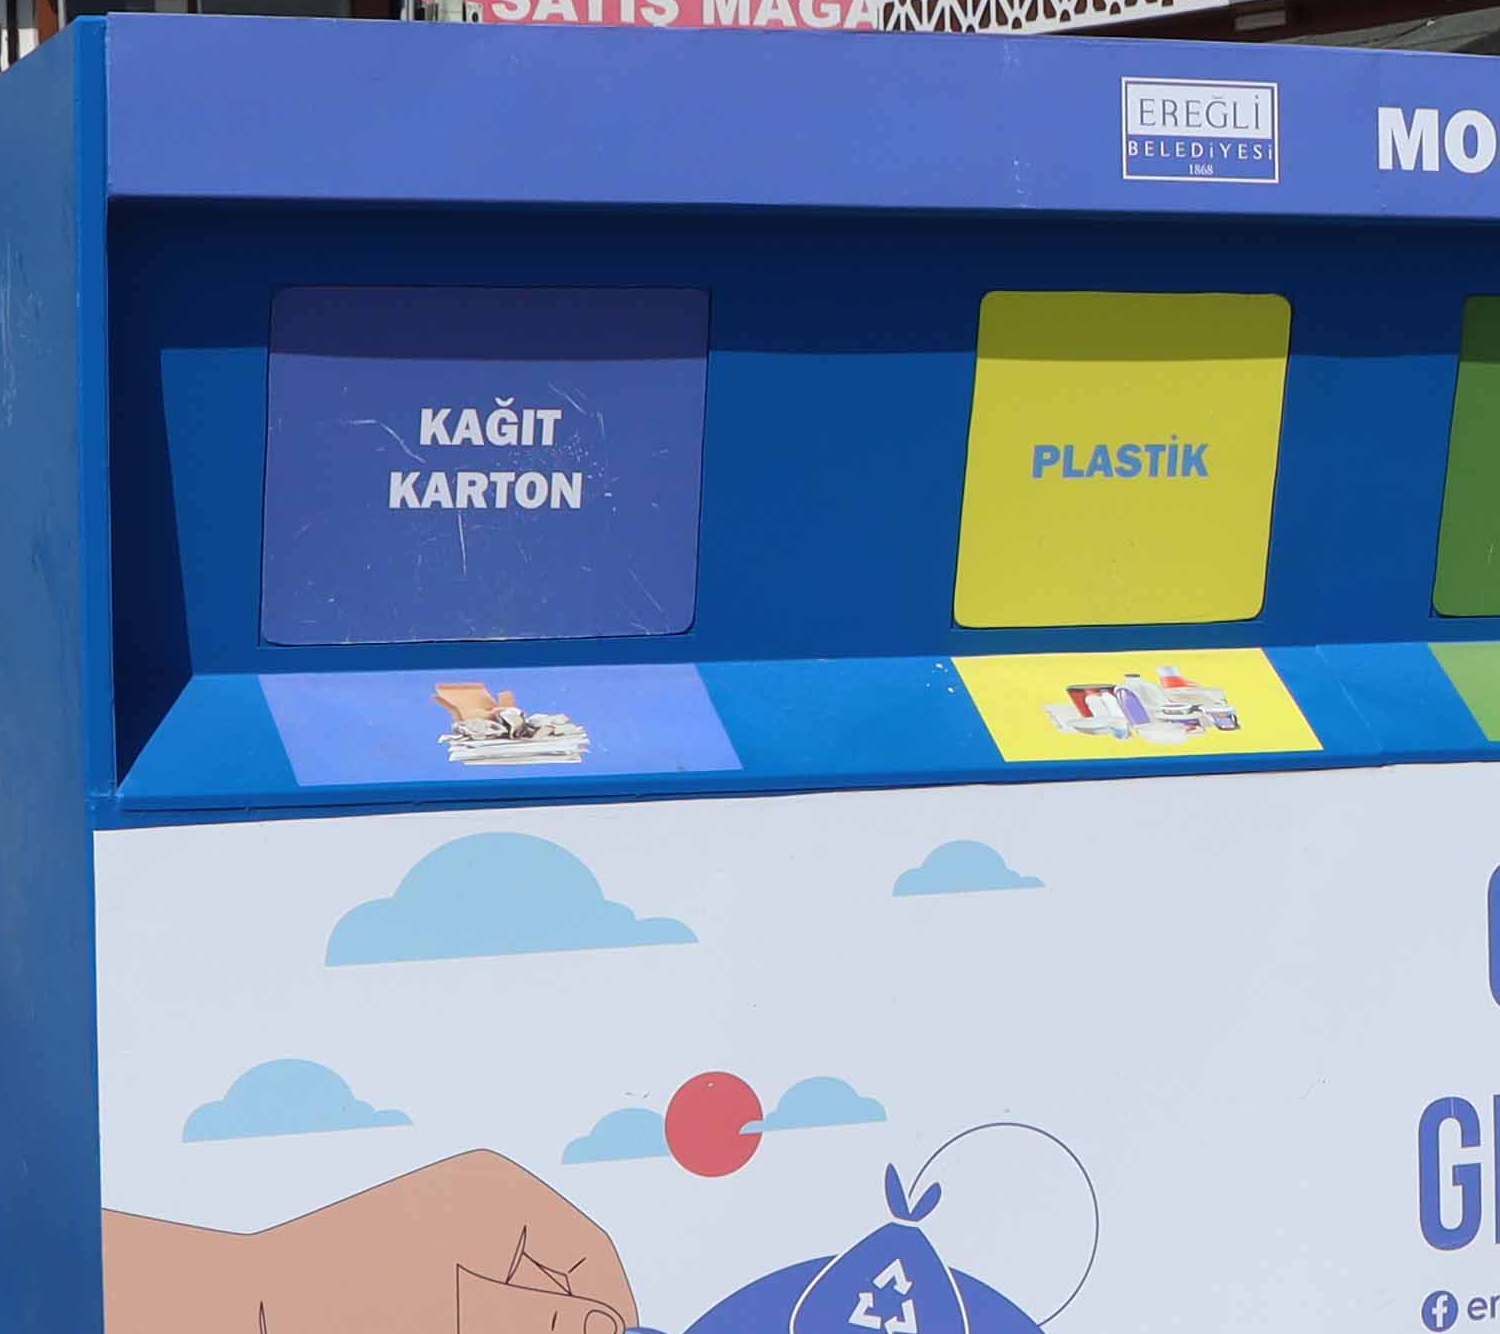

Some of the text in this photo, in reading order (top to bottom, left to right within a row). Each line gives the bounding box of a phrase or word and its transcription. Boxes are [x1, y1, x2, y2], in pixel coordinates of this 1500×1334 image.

[1138, 94, 1262, 132] EREĞLİ
[1187, 162, 1214, 177] 1868
[419, 397, 563, 447] KAĞIT
[1032, 434, 1209, 480] PLASTİK
[388, 471, 583, 511] KARTON
